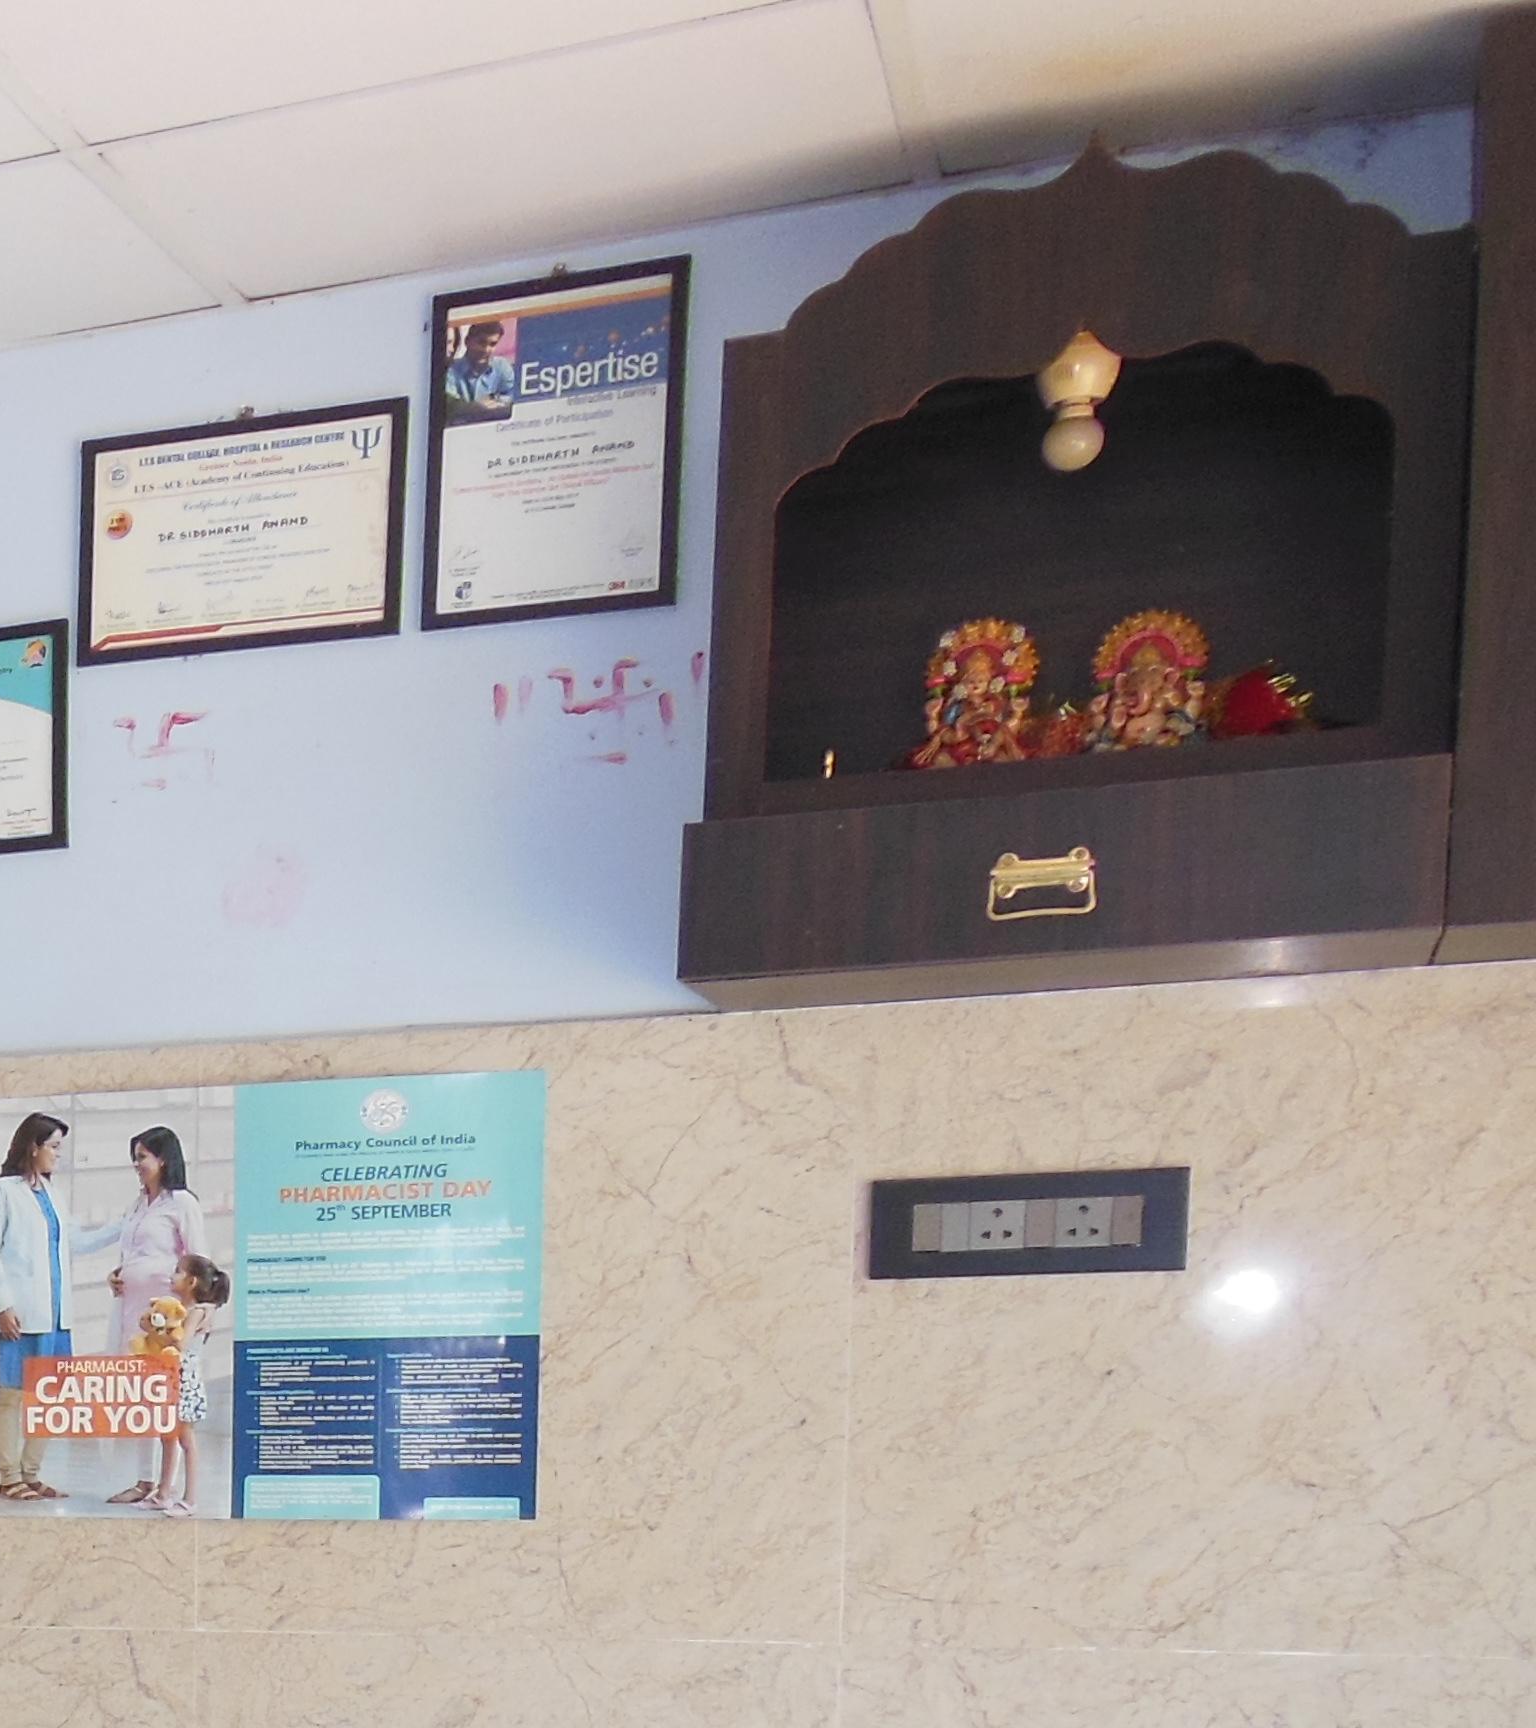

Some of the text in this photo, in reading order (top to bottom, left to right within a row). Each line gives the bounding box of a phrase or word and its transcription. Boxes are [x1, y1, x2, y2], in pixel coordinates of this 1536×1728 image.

[520, 351, 658, 396] Espertise
[295, 1133, 476, 1152] Pharmacy Council of India
[321, 1163, 448, 1182] CELEBRATING
[279, 1180, 492, 1204] PHARMACIST DAY
[351, 1203, 452, 1220] SEPTEMBER
[57, 1360, 147, 1374] PHARMACIST:
[35, 1374, 168, 1404] CARING
[27, 1405, 176, 1434] FOR YOU
